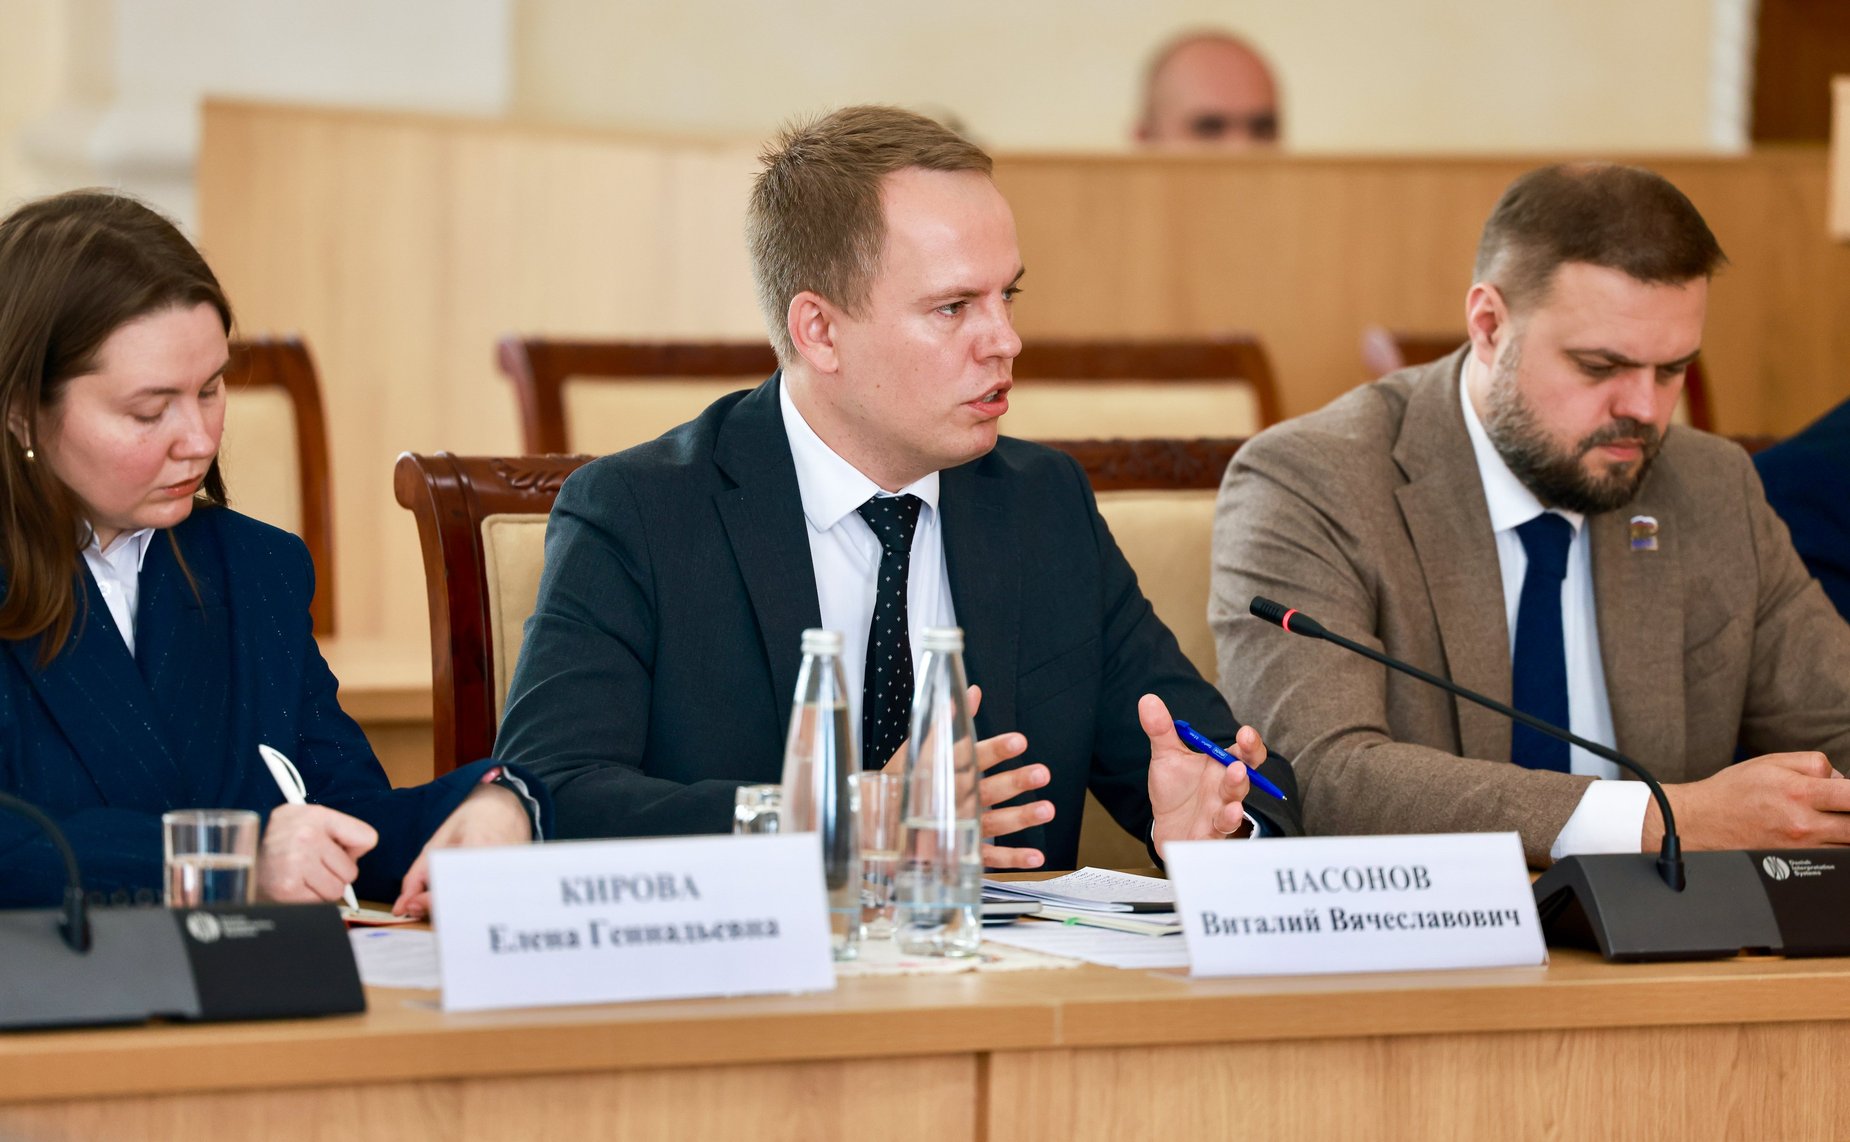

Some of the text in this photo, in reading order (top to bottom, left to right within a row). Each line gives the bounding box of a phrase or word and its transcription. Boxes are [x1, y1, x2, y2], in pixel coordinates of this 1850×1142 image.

[560, 873, 700, 905] КИРОВА
[1275, 865, 1432, 894] НАСОНОВ
[489, 916, 780, 953] Елена Геннадьевна
[1201, 906, 1521, 937] Виталий Вячеславович
